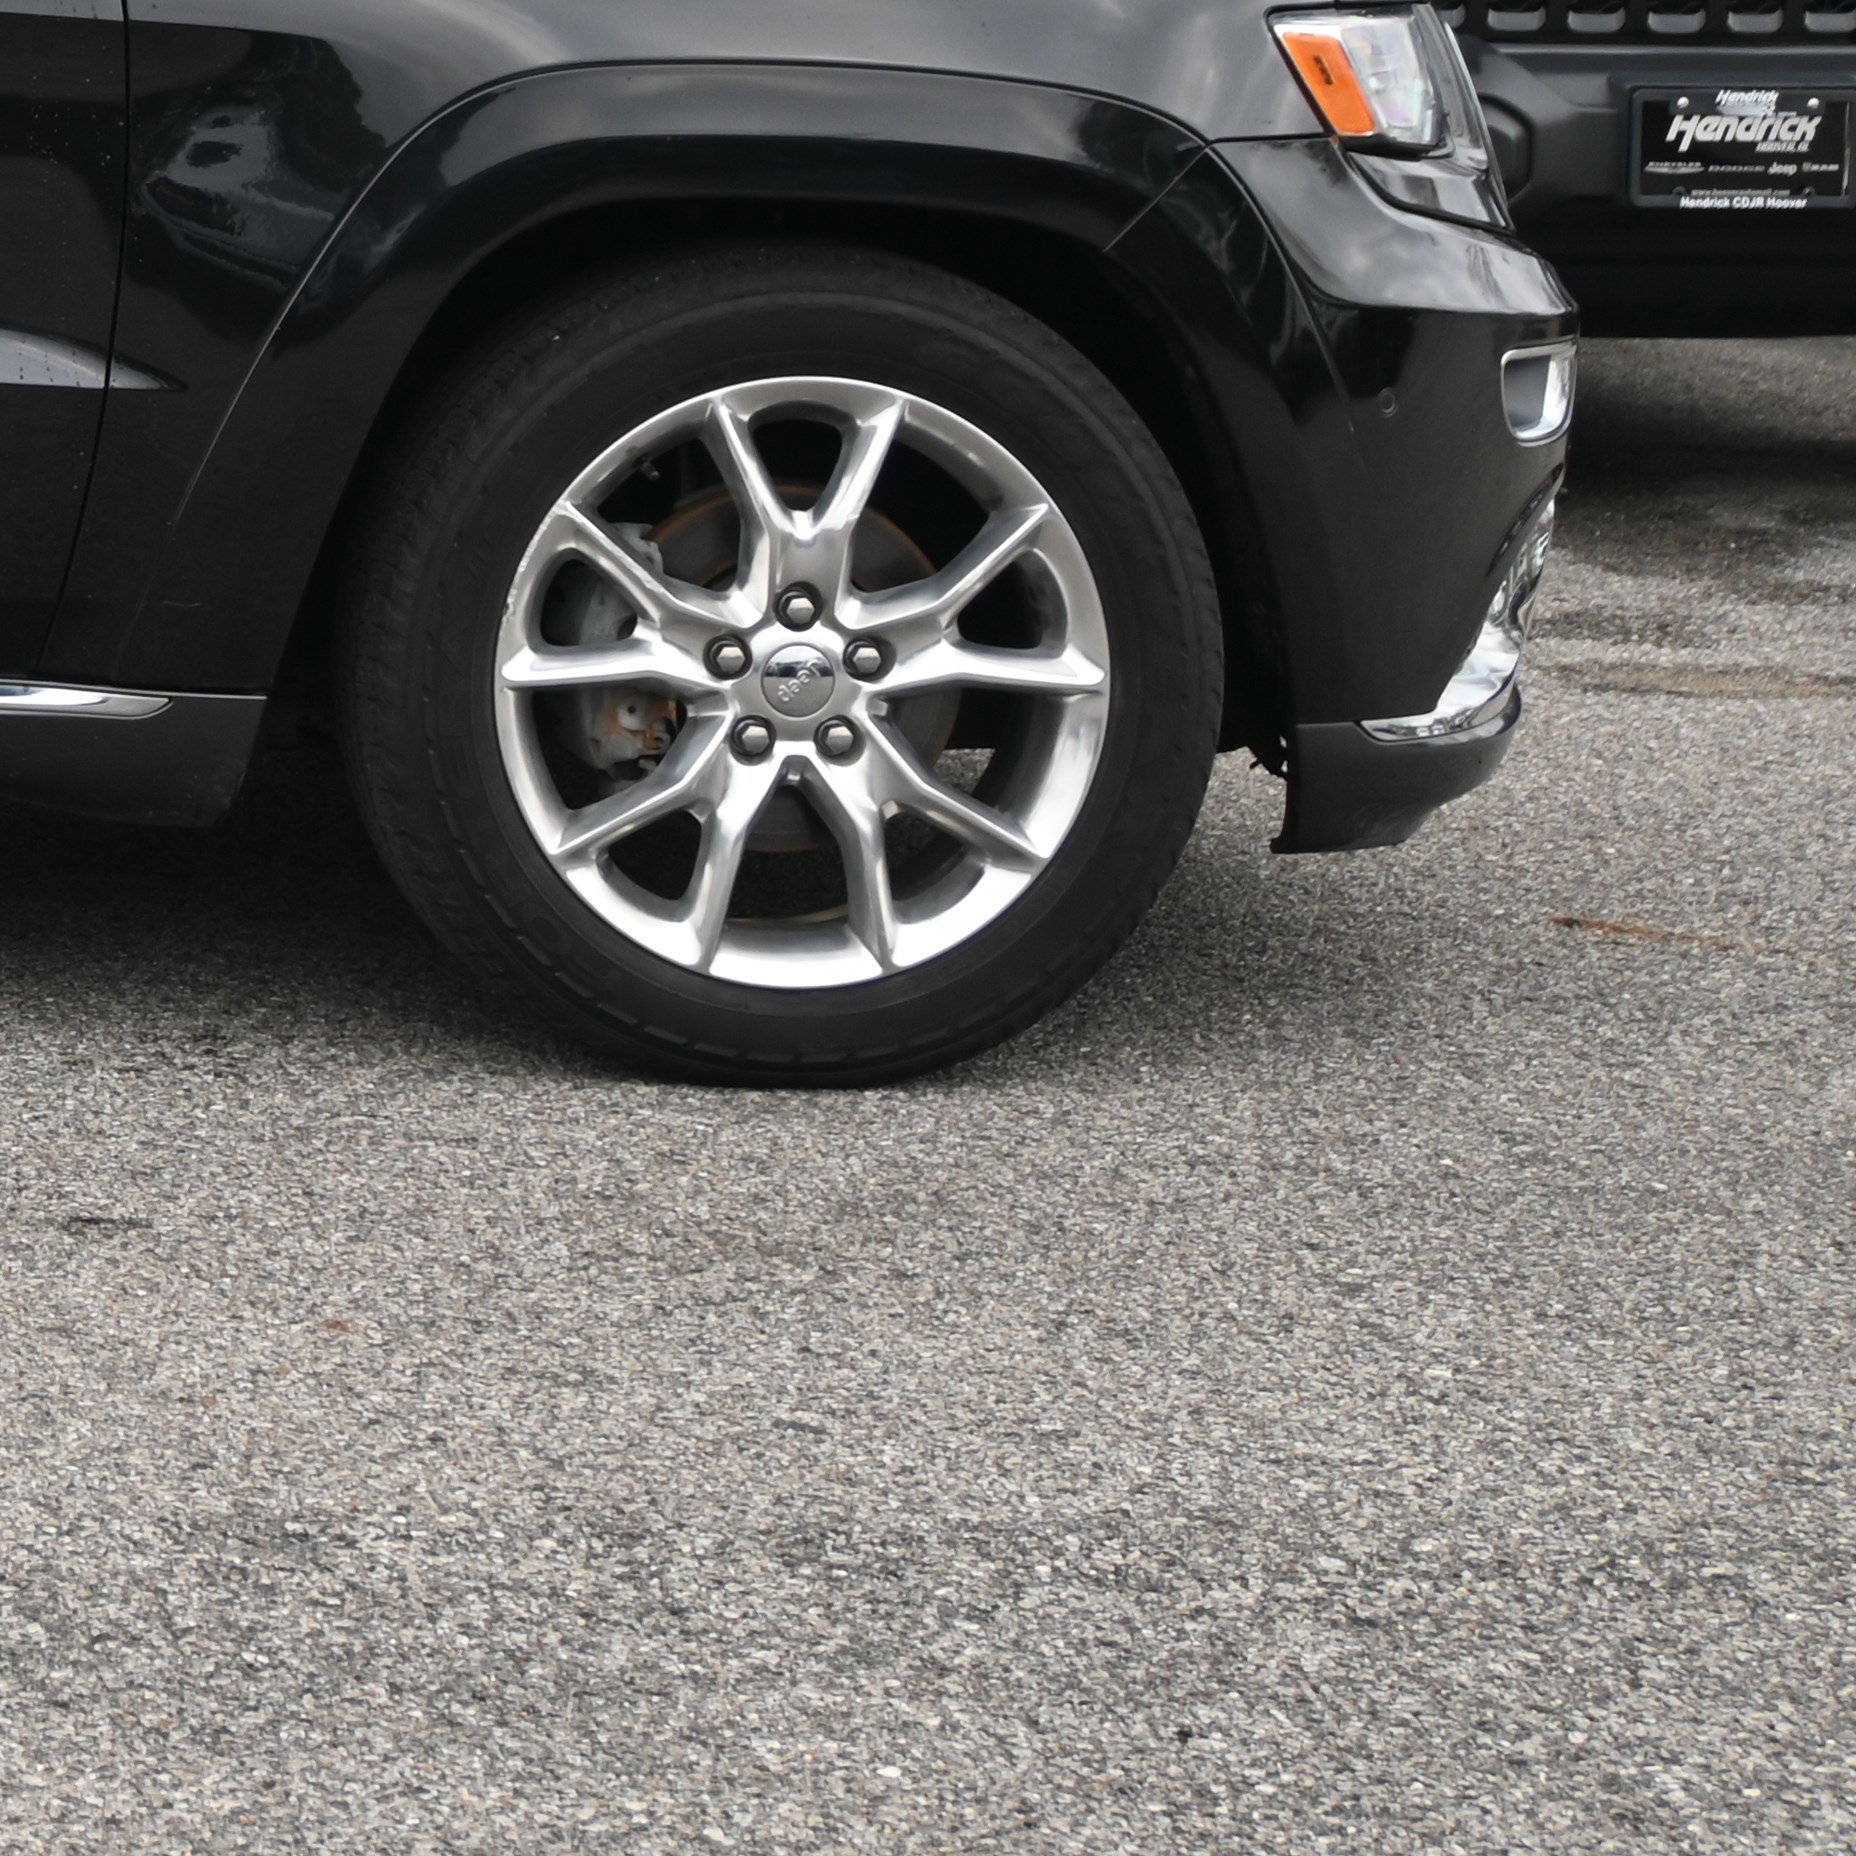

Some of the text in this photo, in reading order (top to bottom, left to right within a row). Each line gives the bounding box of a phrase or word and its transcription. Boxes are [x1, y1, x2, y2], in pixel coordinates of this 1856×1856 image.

[1665, 114, 1822, 153] Hendrick
[1679, 196, 1808, 209] Hendrick CDJR Hoover
